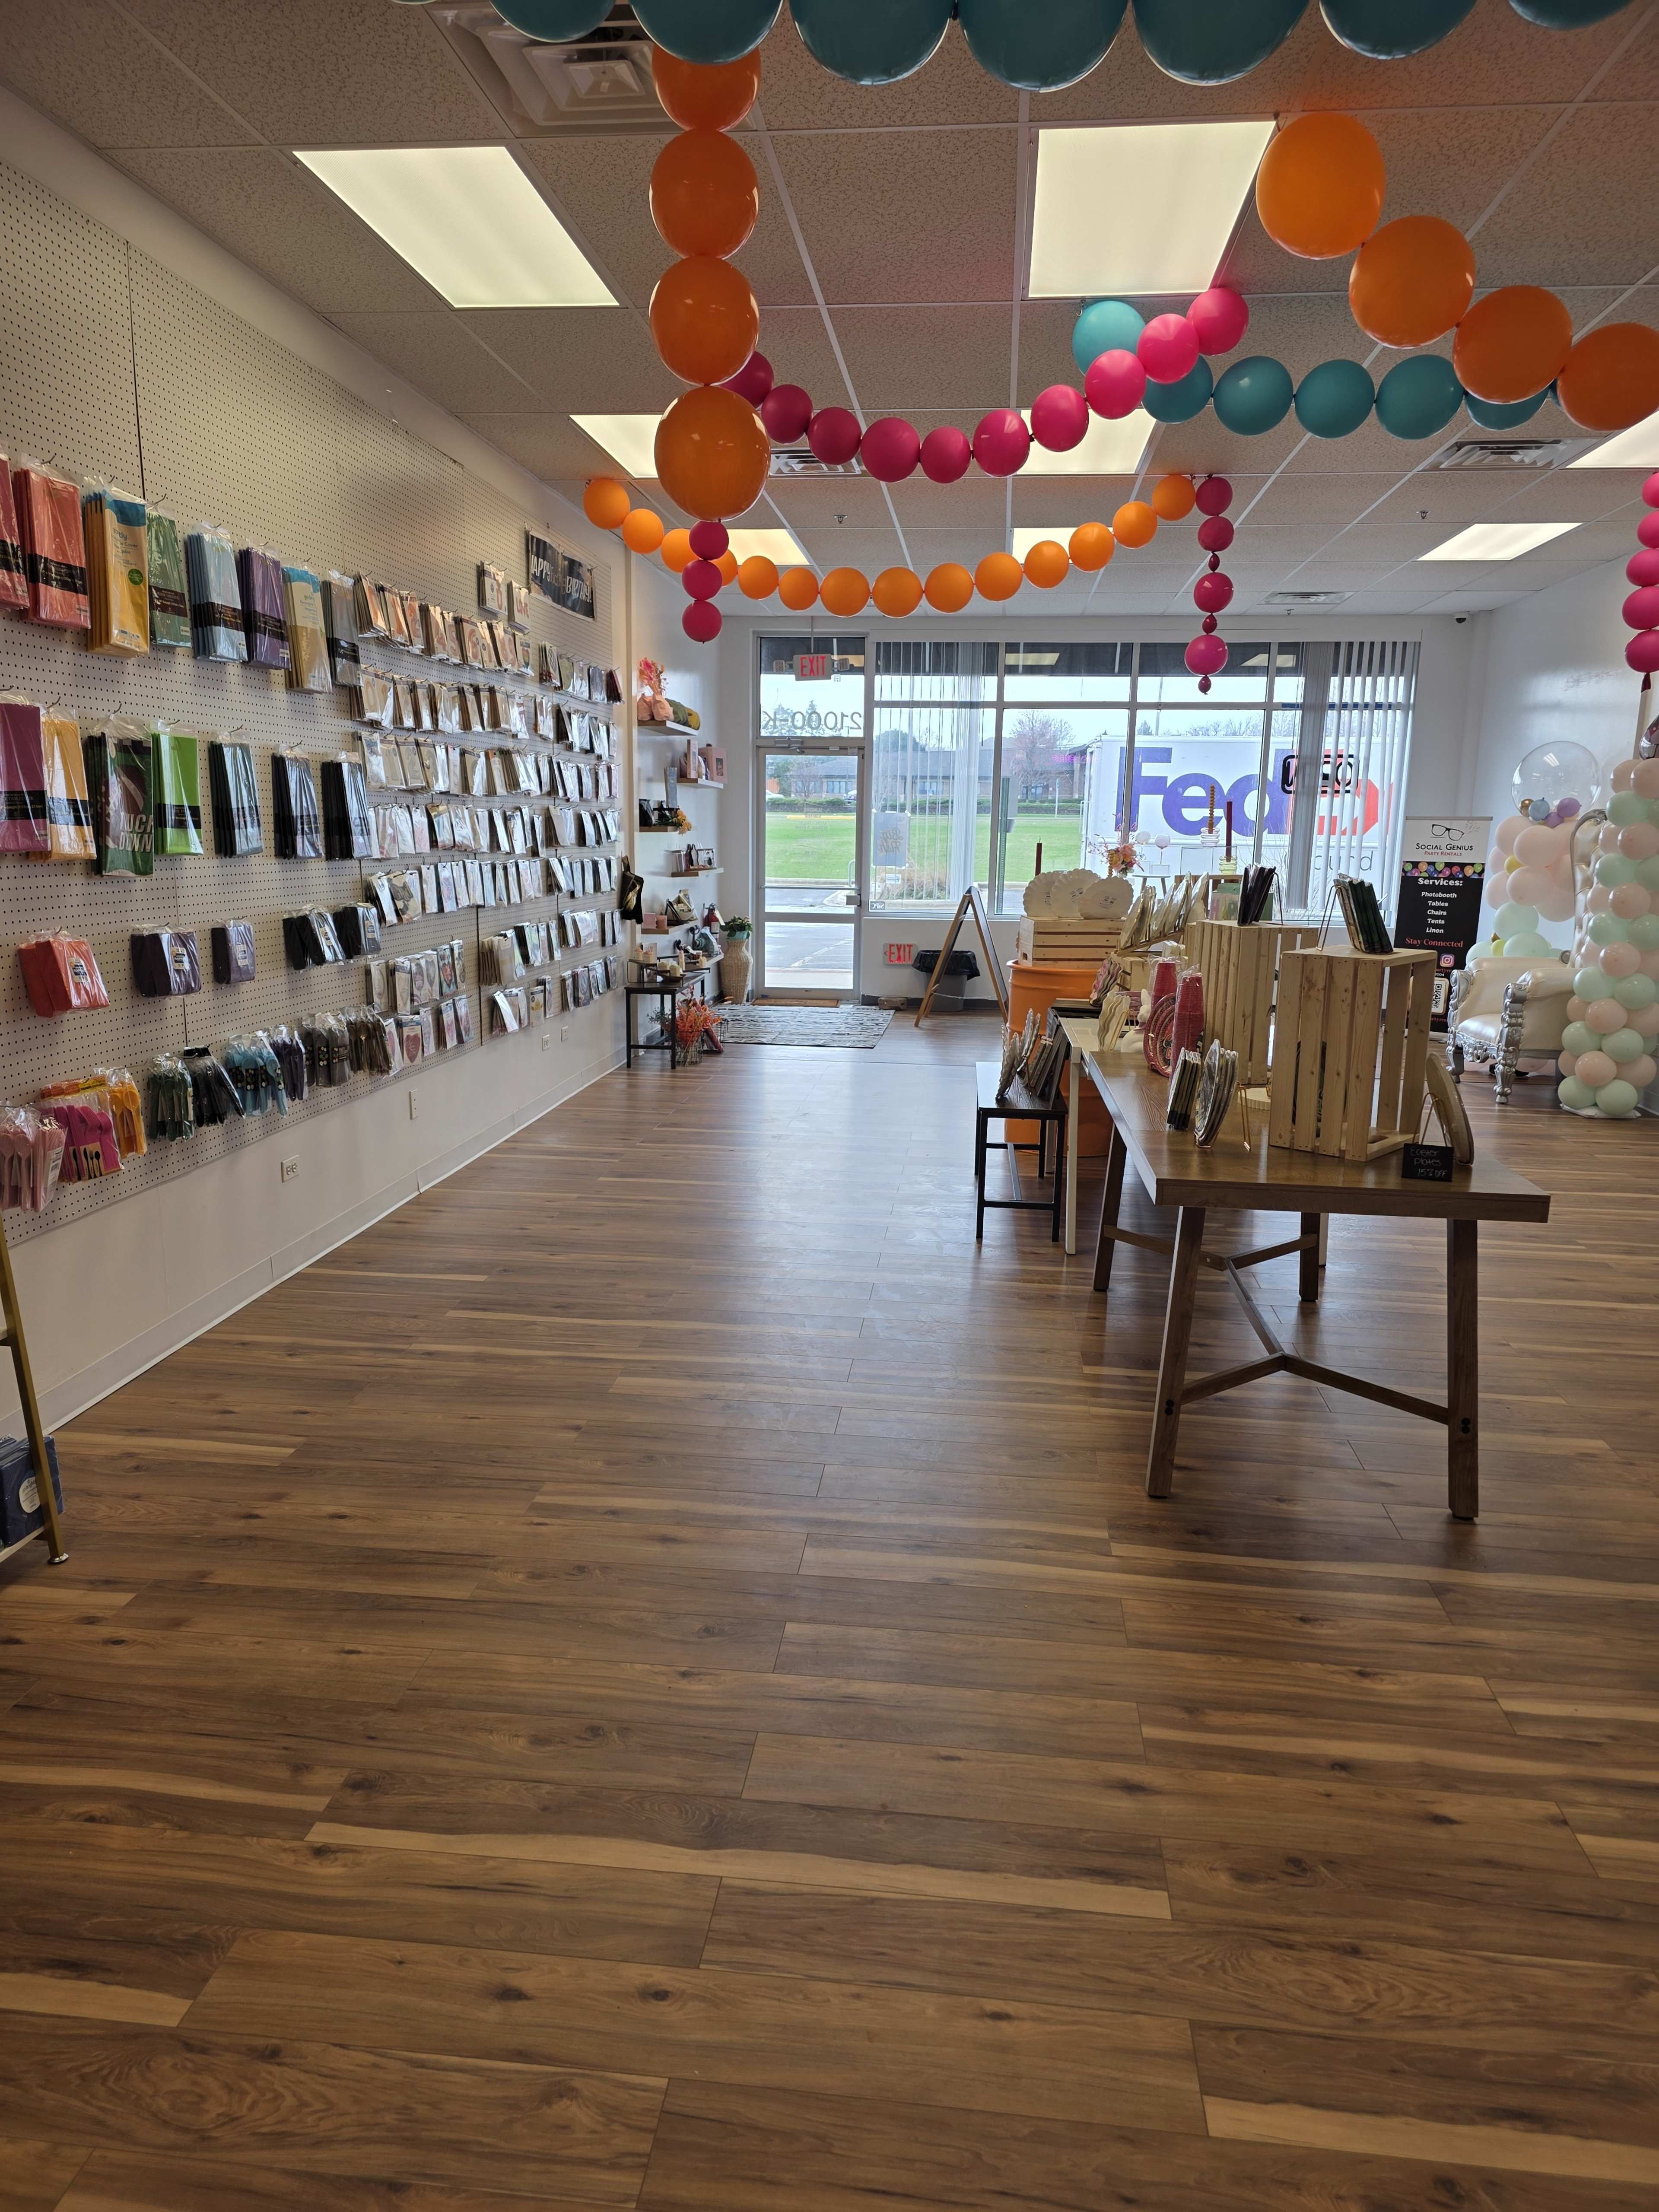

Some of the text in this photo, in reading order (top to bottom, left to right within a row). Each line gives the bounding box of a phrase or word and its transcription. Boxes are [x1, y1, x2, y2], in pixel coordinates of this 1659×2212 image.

[799, 655, 826, 677] EXIT
[1417, 877, 1463, 886] Services:
[1405, 937, 1464, 948] Stay Connected
[888, 943, 914, 964] EXIT
[1410, 1146, 1440, 1157] Easter
